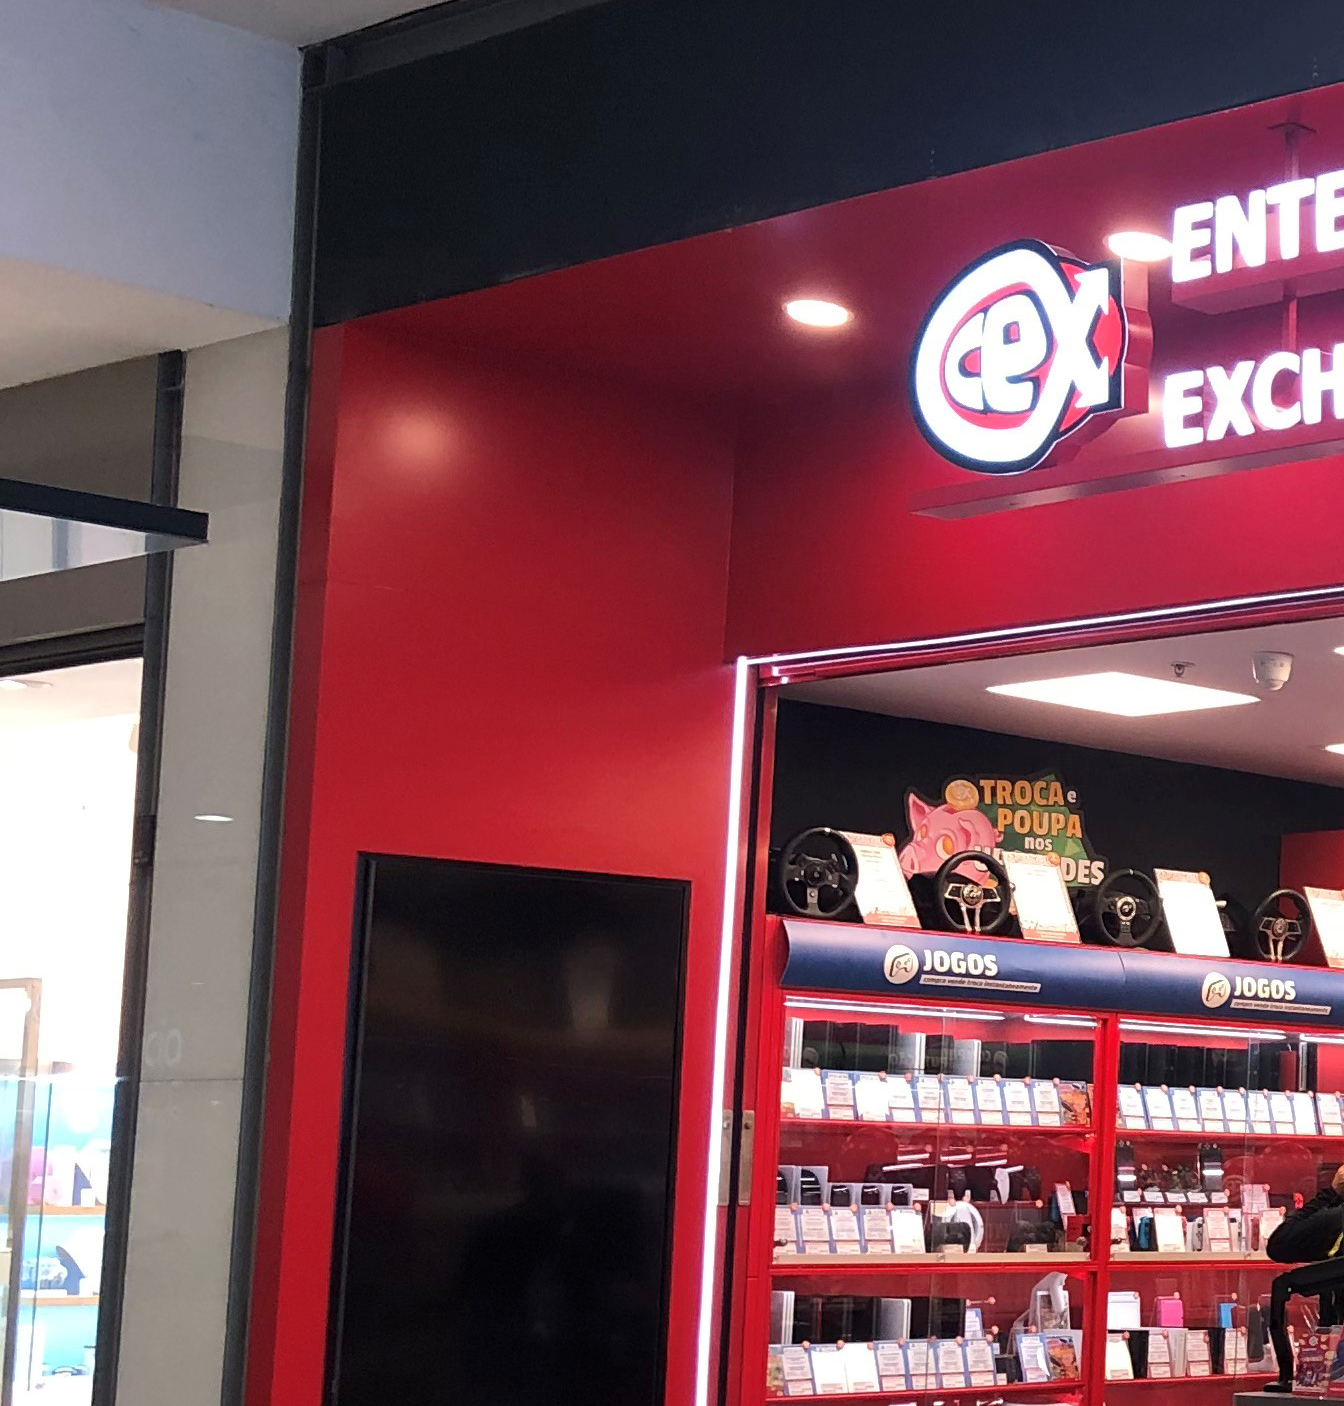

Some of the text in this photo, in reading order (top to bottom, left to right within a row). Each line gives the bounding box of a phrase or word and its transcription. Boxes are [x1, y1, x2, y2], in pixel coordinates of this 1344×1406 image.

[979, 779, 1064, 806] TROCA
[997, 808, 1082, 838] POUPA
[1025, 837, 1052, 851] nos
[923, 949, 999, 977] JOGOS
[1234, 976, 1297, 1000] JOGOS
